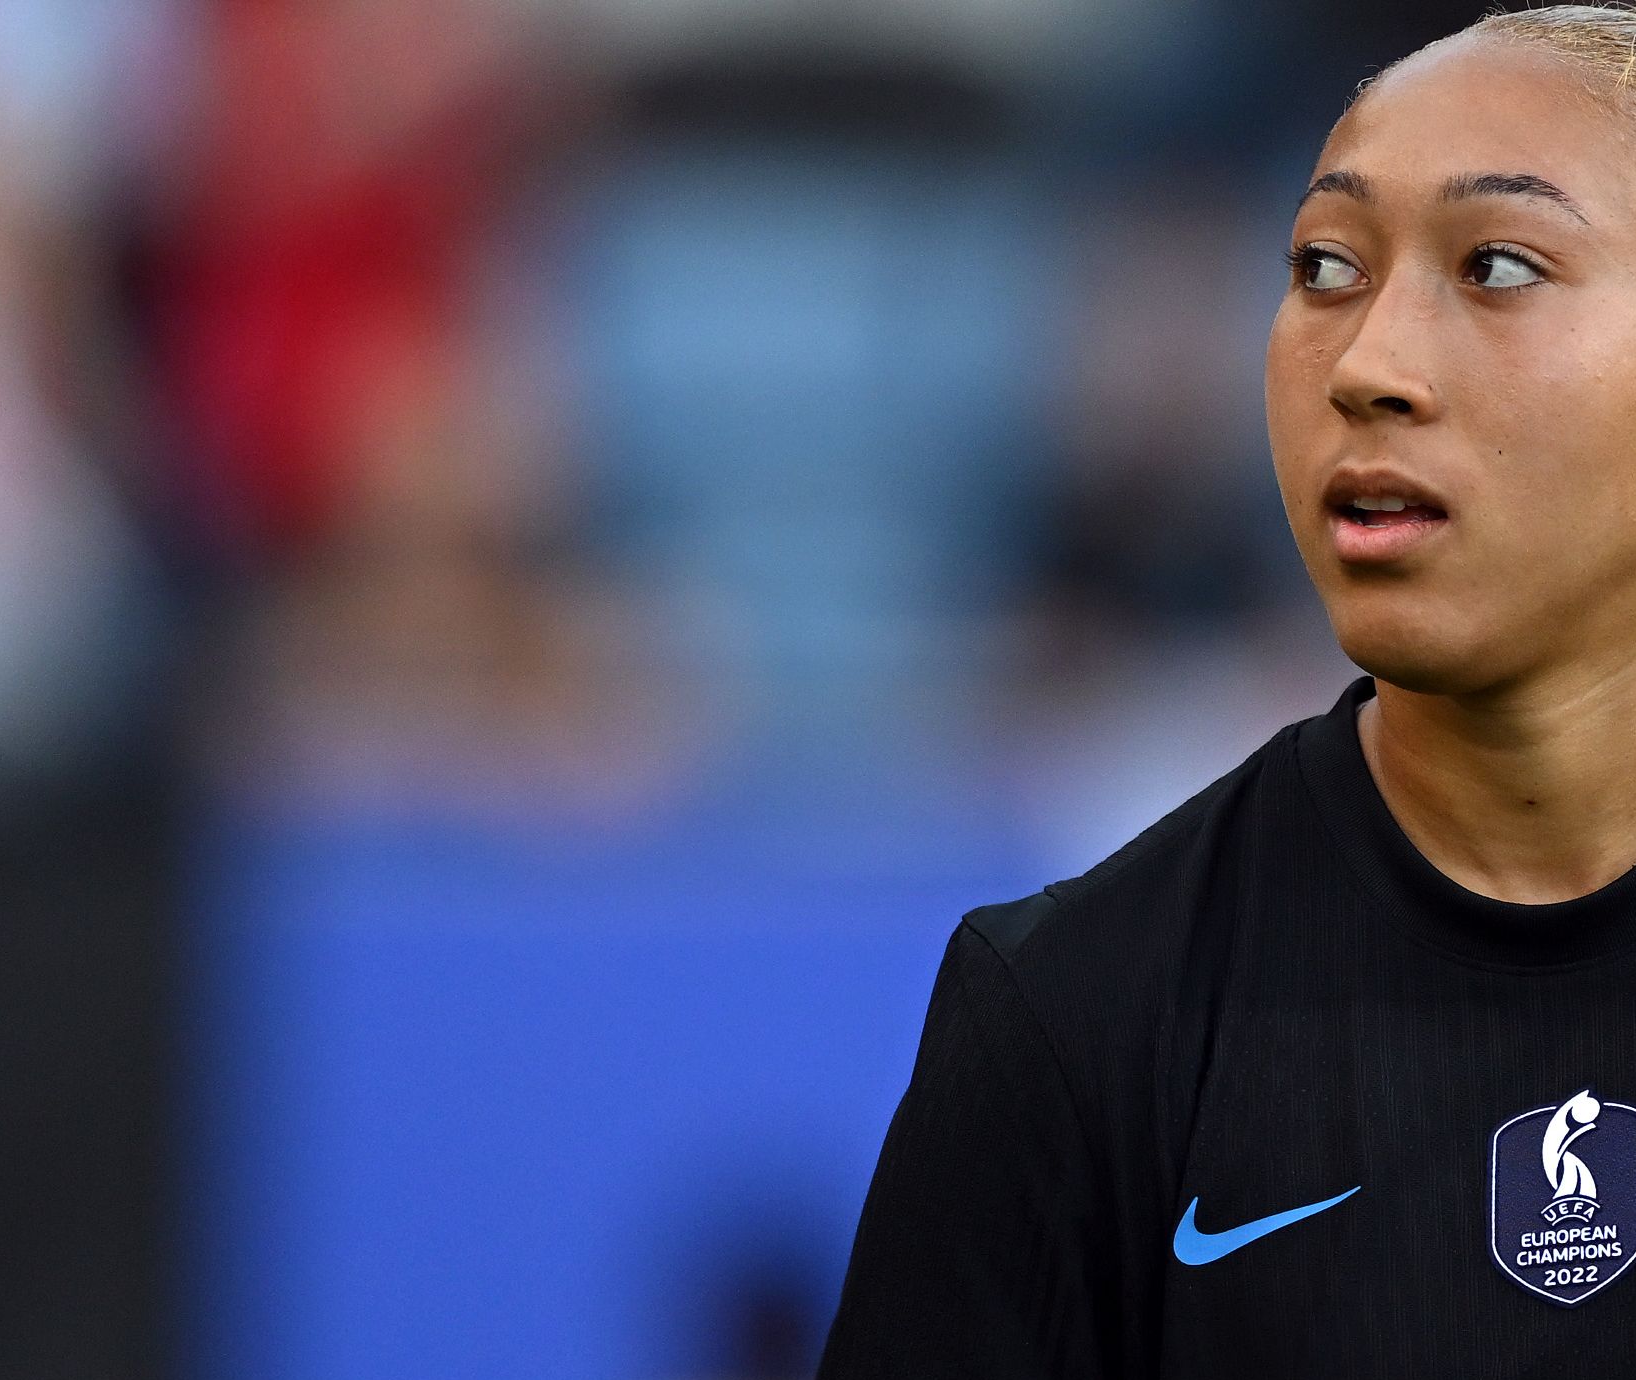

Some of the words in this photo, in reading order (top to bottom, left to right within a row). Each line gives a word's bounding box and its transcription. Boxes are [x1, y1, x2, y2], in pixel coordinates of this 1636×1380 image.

[1543, 1202, 1596, 1222] UEFA
[1521, 1225, 1617, 1248] EUROPEAN
[1516, 1242, 1622, 1266] CHAMPIONS
[1544, 1265, 1598, 1286] 2022
